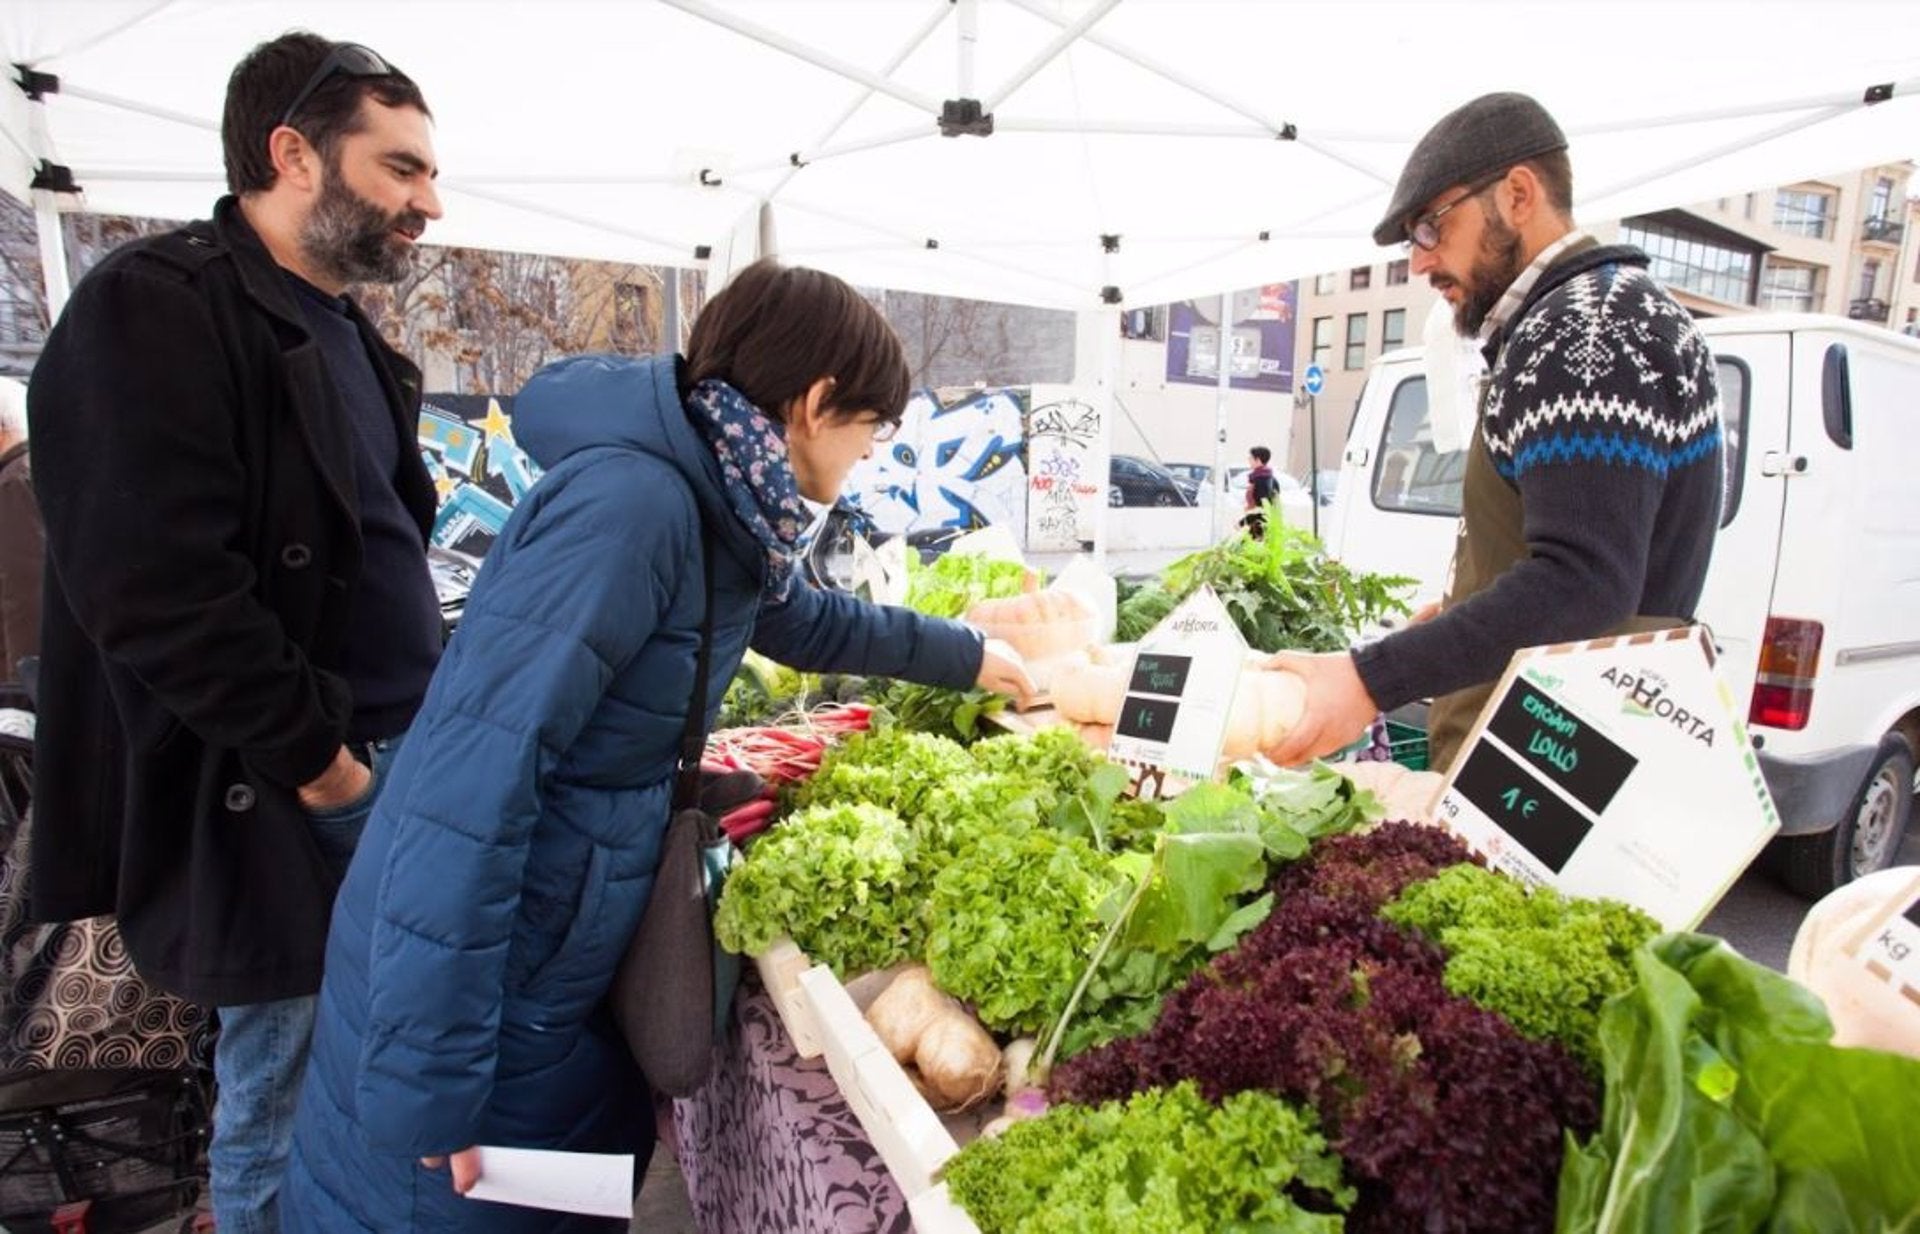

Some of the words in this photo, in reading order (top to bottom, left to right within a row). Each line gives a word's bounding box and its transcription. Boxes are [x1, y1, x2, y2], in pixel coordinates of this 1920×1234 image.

[1600, 667, 1717, 748] APHORTA
[1441, 796, 1460, 819] kg
[1878, 929, 1912, 962] kg
